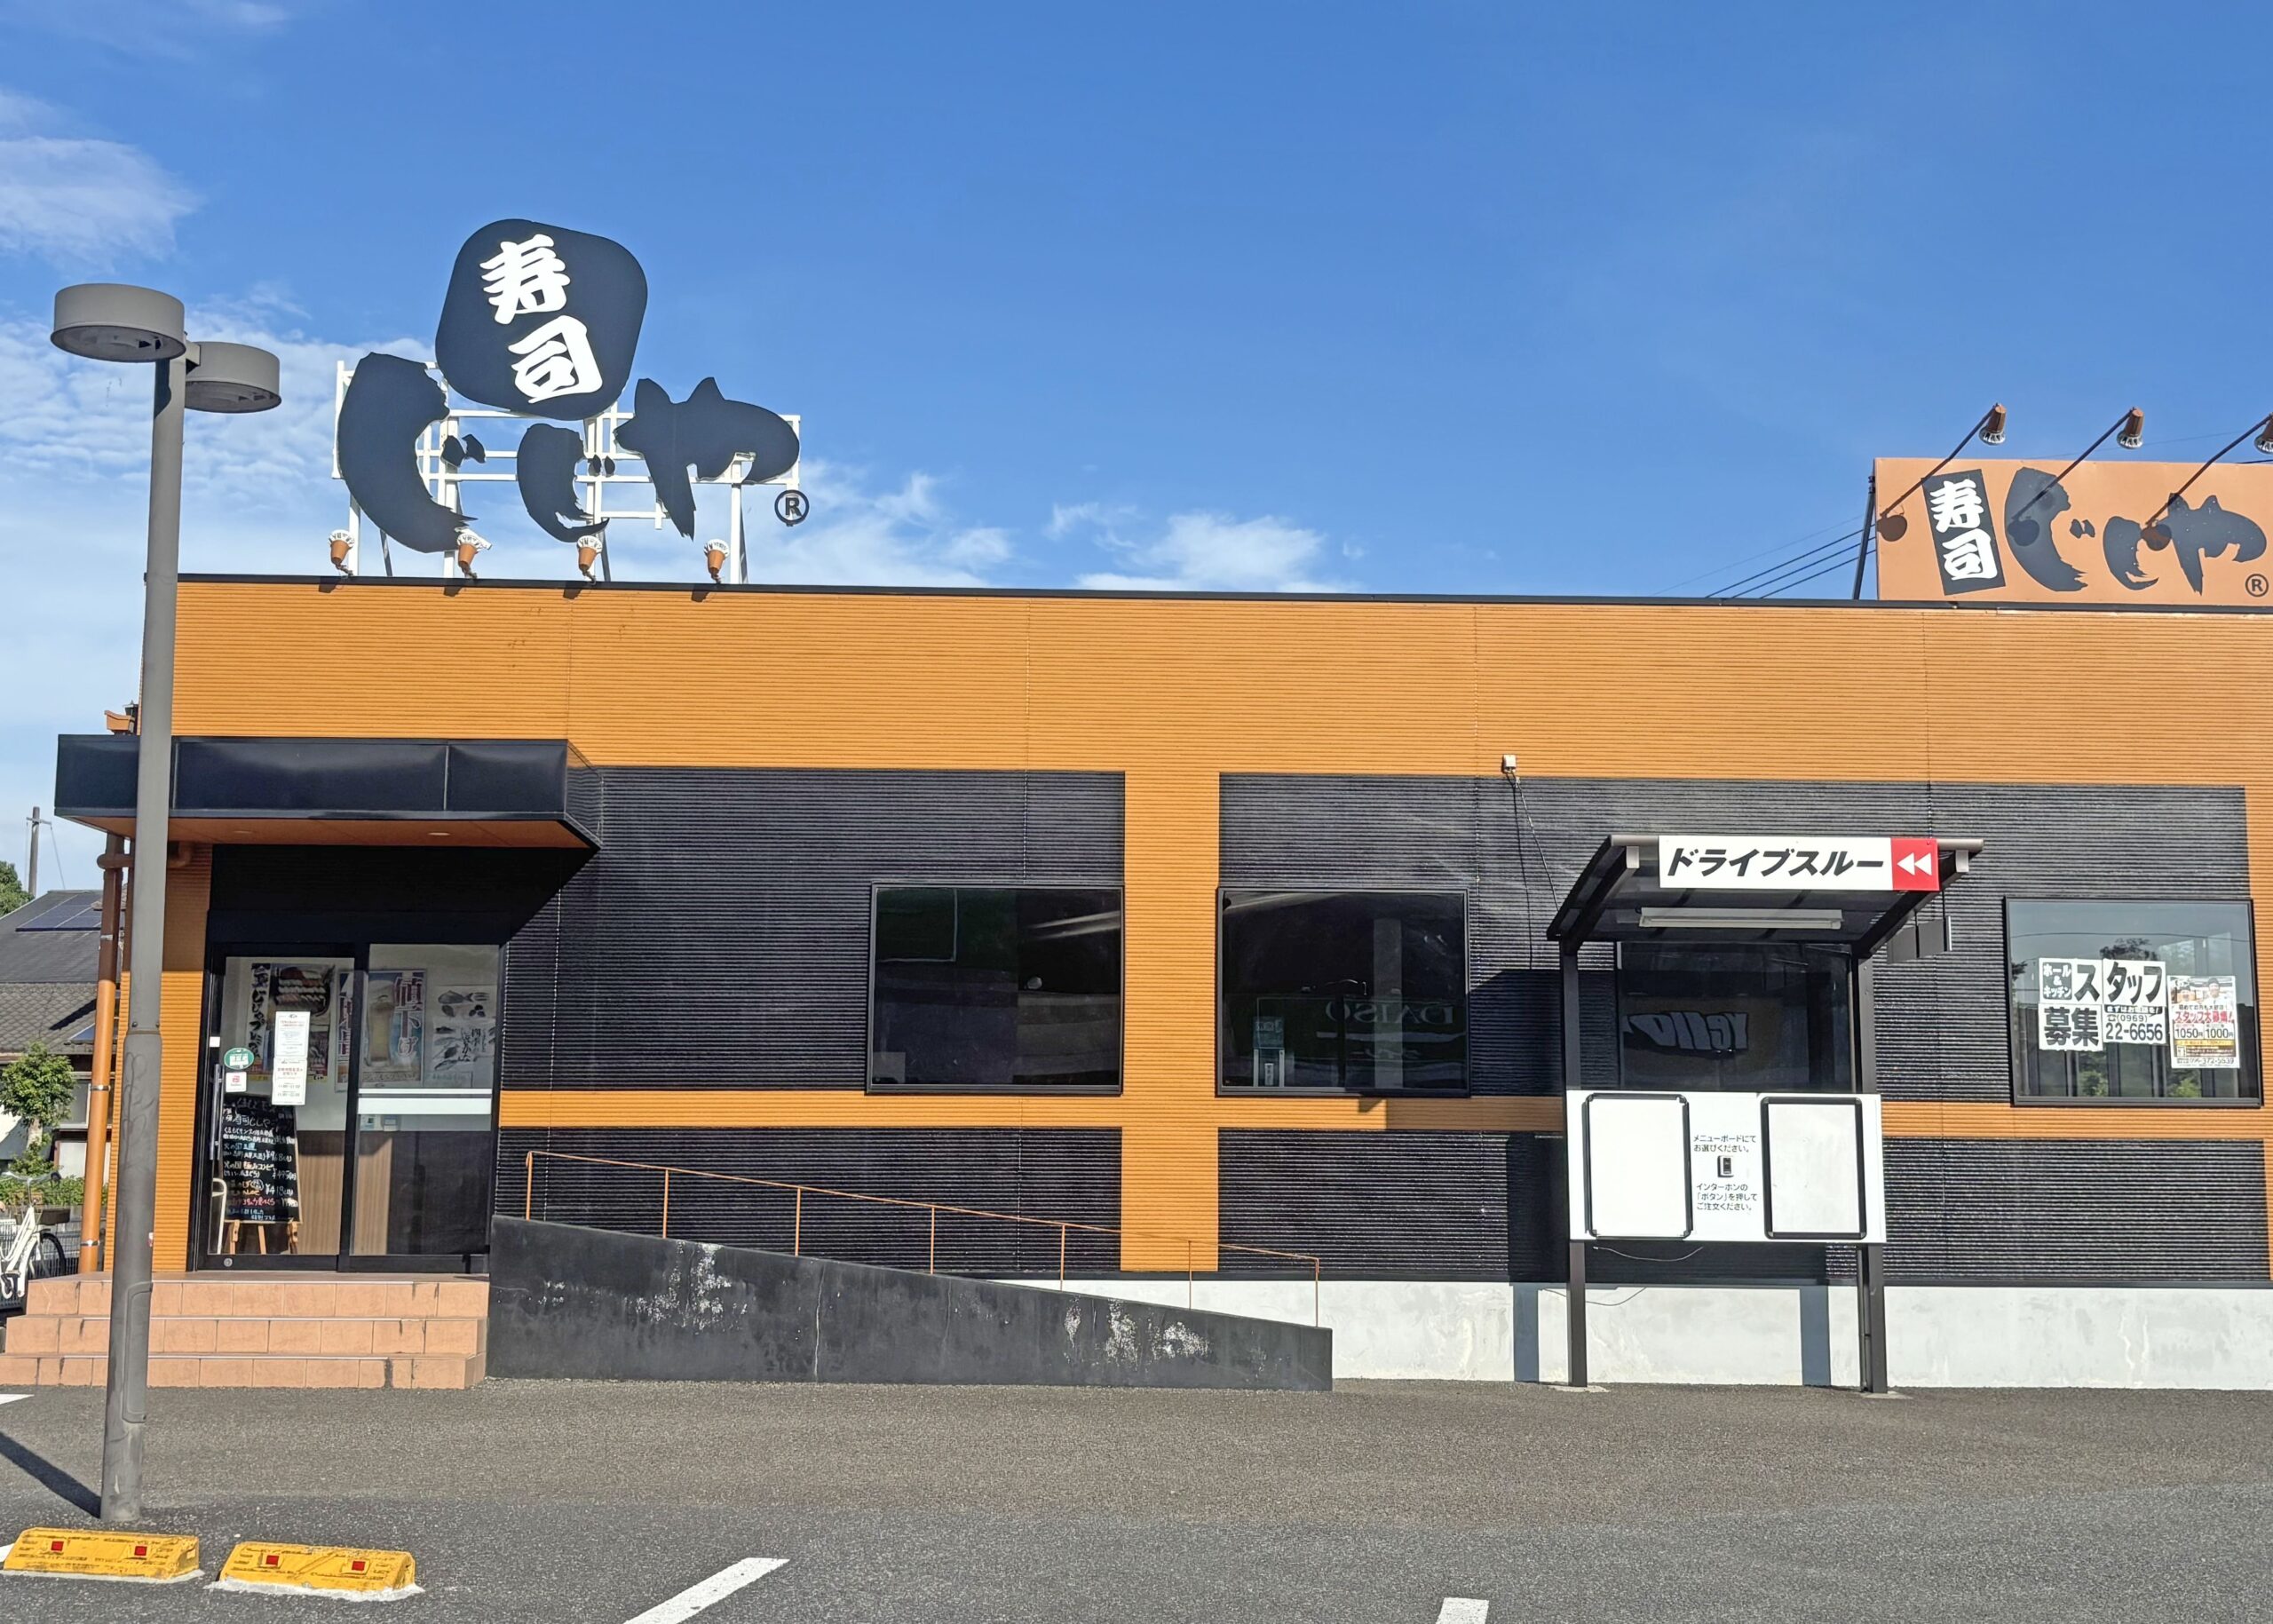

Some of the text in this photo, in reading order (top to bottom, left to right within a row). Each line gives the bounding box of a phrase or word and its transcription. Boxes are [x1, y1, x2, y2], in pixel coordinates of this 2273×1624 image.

[480, 234, 604, 403] 寿司
[1930, 479, 1998, 581] 寿司
[1667, 847, 1883, 877] ドライブスルー
[2043, 963, 2071, 977] ホール
[2053, 975, 2063, 986] &
[2074, 962, 2163, 1004] スタッフ
[2043, 985, 2071, 998] キッチン
[395, 972, 424, 1057] 値下げ
[2044, 1006, 2100, 1046] 募集
[2105, 1022, 2163, 1041] 22-6656
[1693, 1134, 1757, 1143] メニューボードにて
[1693, 1144, 1750, 1153] お選びください。
[1697, 1183, 1748, 1192] インターホンの
[1698, 1192, 1758, 1201] 「ボタン」を押して
[1697, 1202, 1752, 1211] ご注文ください。
